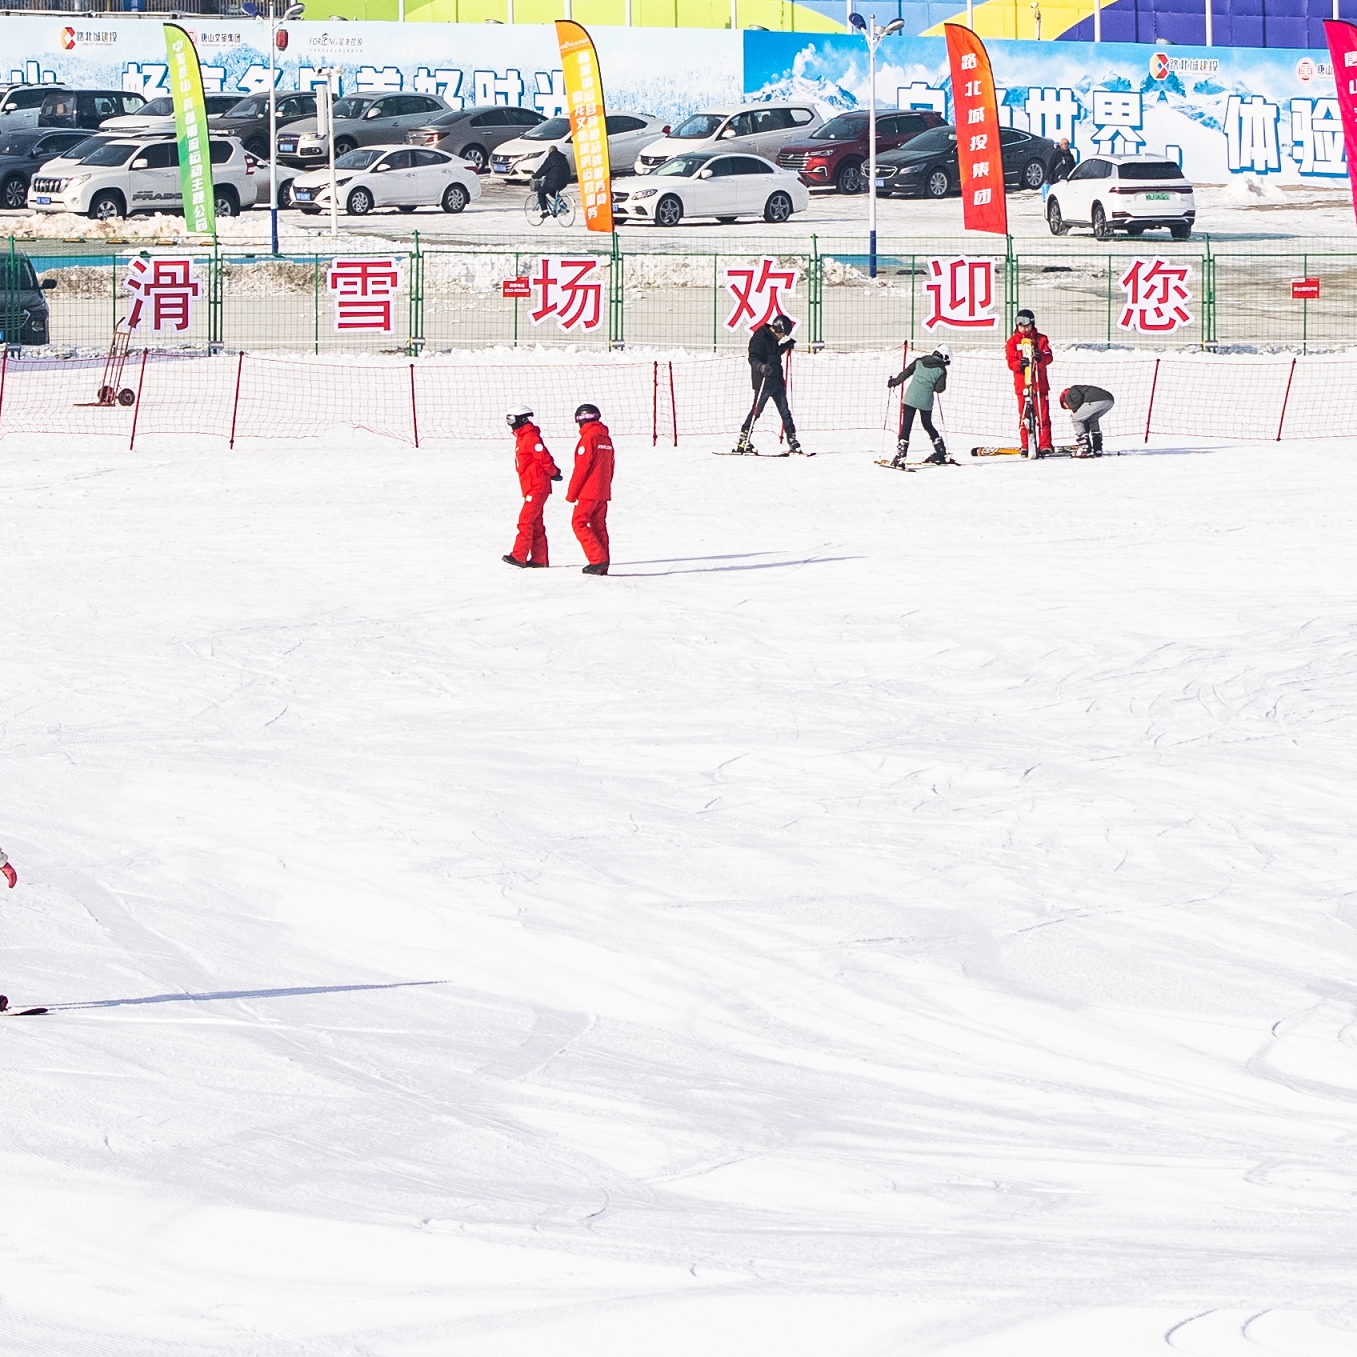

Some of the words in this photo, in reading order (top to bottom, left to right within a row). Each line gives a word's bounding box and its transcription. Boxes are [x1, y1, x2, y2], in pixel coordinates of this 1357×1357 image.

[961, 53, 992, 207] 路北城投集团
